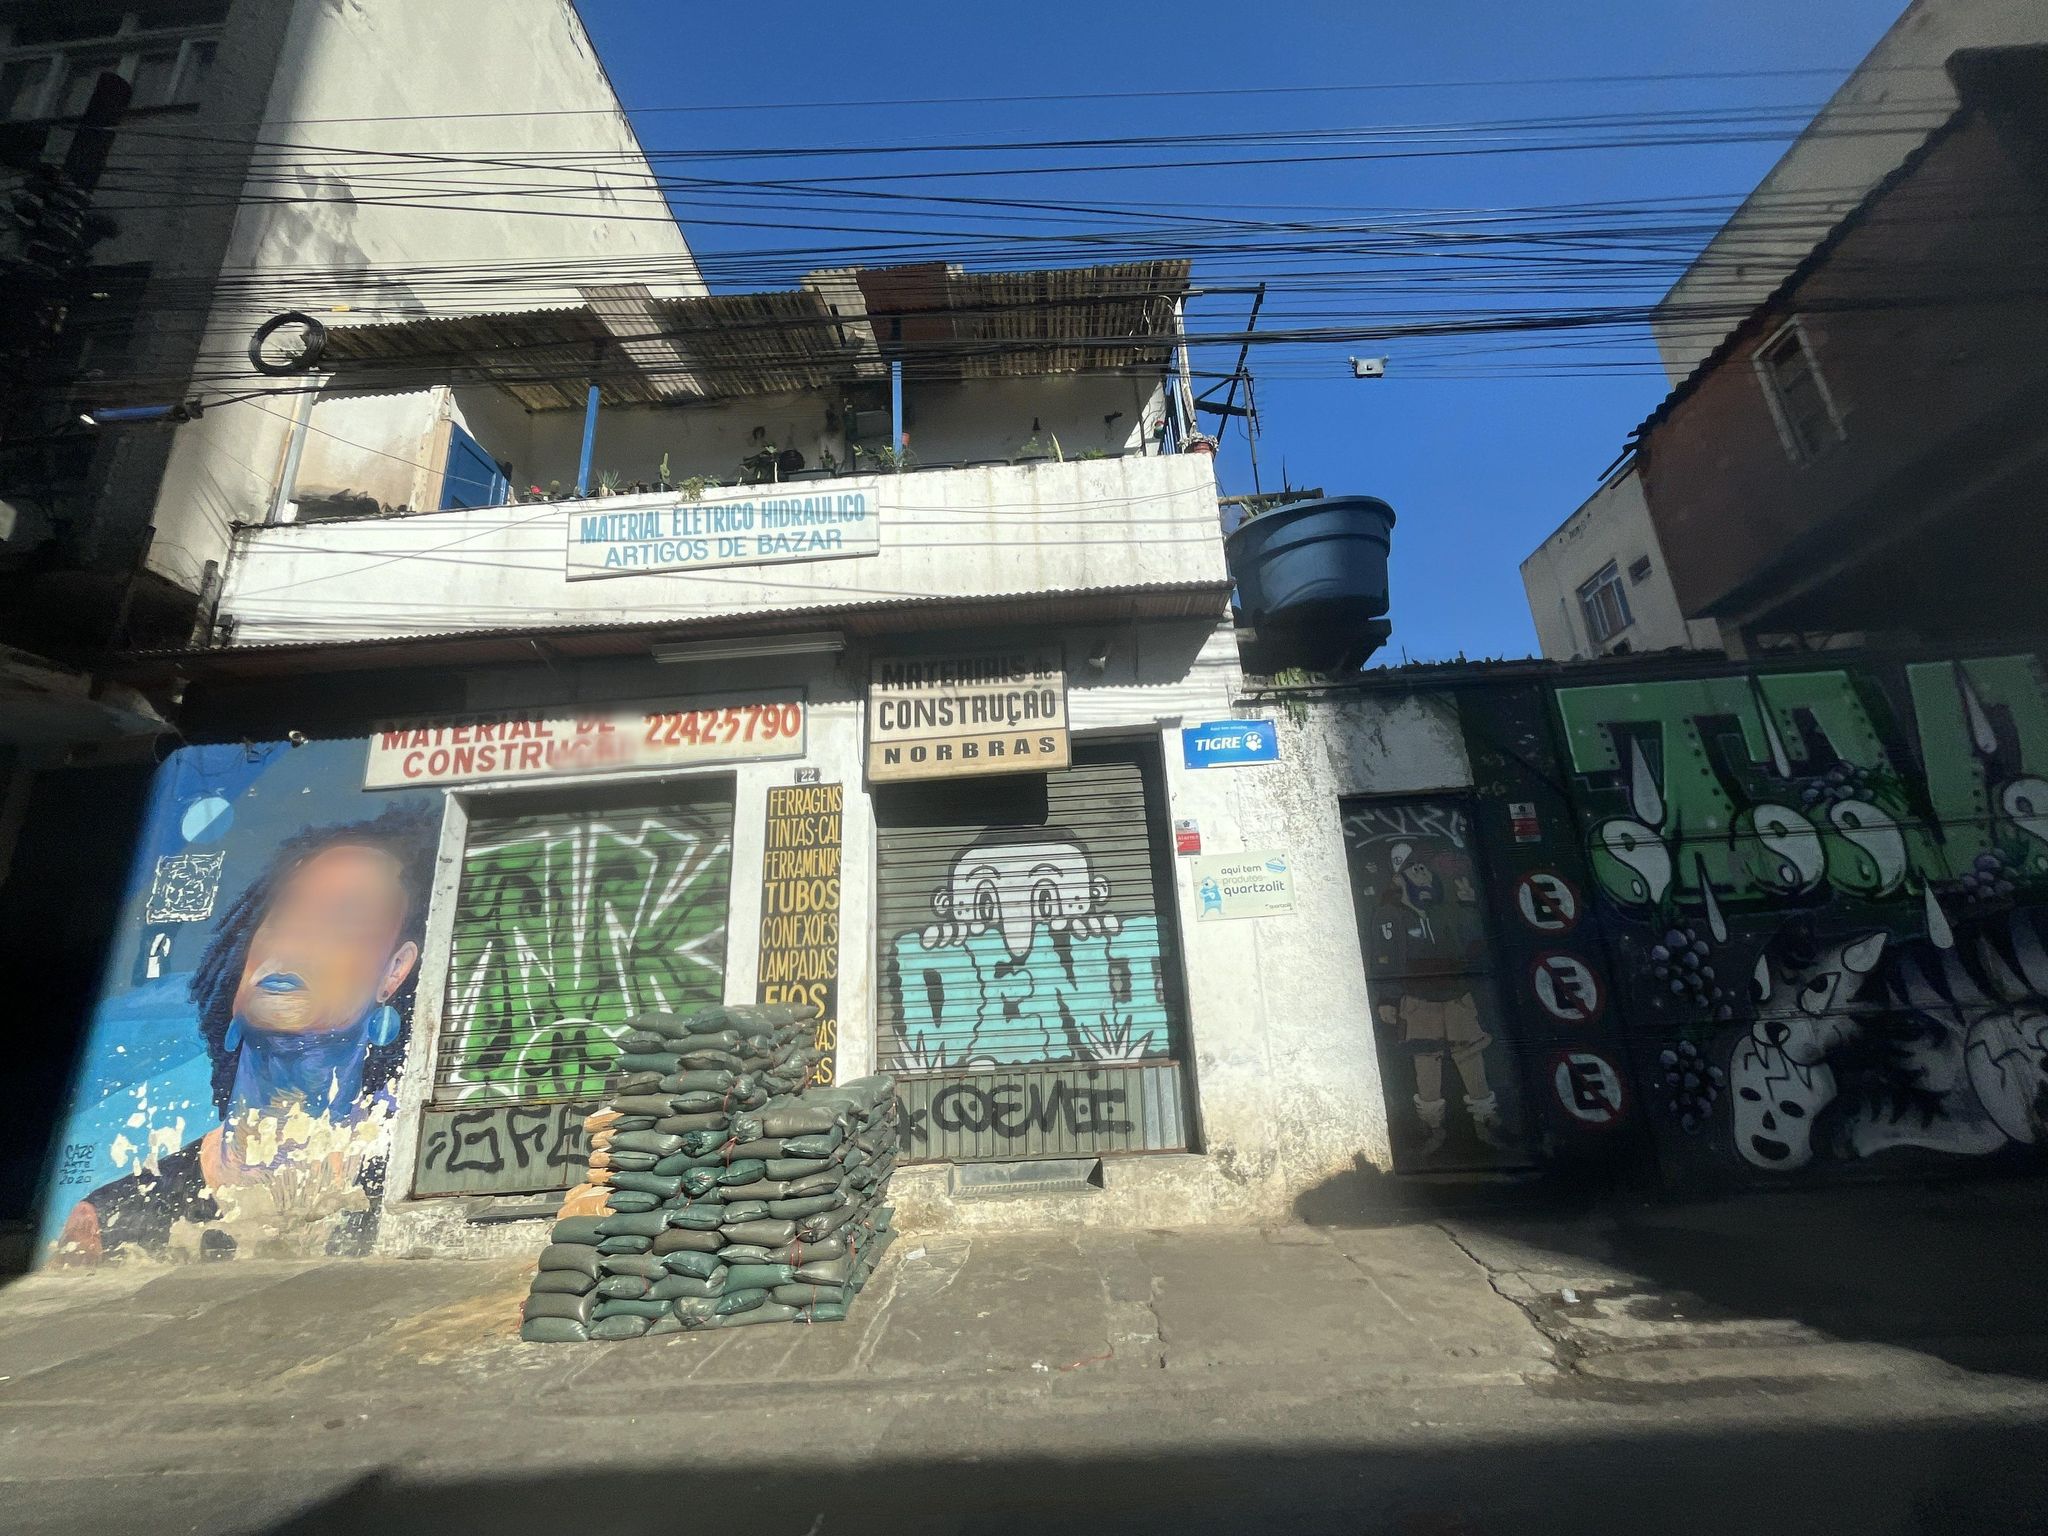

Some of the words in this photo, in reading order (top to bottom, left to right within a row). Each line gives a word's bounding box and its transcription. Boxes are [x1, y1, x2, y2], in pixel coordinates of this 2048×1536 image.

[580, 511, 664, 544] MATERIAL
[760, 493, 866, 529] HIDRAULICO
[604, 538, 708, 568] ARTIGOS
[718, 536, 748, 558] DE
[757, 528, 842, 555] BAZAR
[879, 684, 1056, 731] CONSTRUÇÃO
[380, 709, 554, 751] MATERIAL
[1195, 736, 1241, 751] TIGRE
[884, 736, 1056, 765] NORBRAS
[800, 770, 815, 782] 22
[770, 786, 843, 817] FERRAGENS
[764, 848, 841, 881] FERRAMENTAS
[1221, 865, 1241, 875] aqui
[765, 879, 840, 914] TUBOS
[1223, 880, 1285, 897] quartzolit
[761, 911, 838, 949] CONEXÕES
[59, 1175, 92, 1185] 2020
